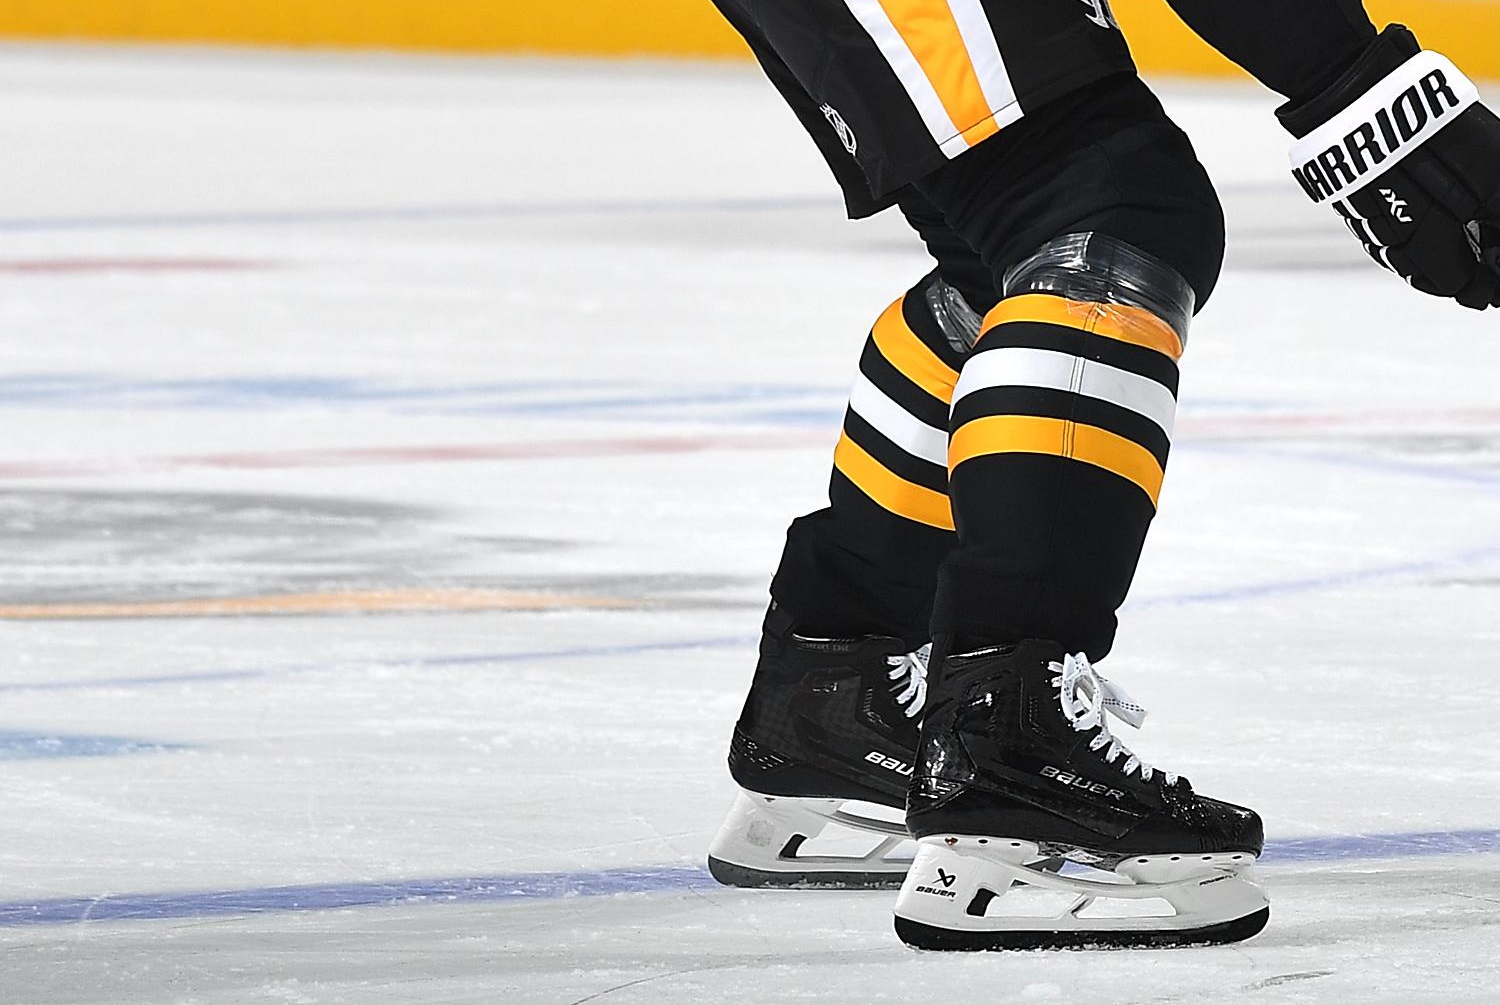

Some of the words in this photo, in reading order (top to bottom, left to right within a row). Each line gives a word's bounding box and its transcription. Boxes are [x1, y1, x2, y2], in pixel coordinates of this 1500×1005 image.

[864, 751, 916, 776] BAU
[1040, 765, 1125, 801] BAUER
[915, 885, 956, 898] BAUER
